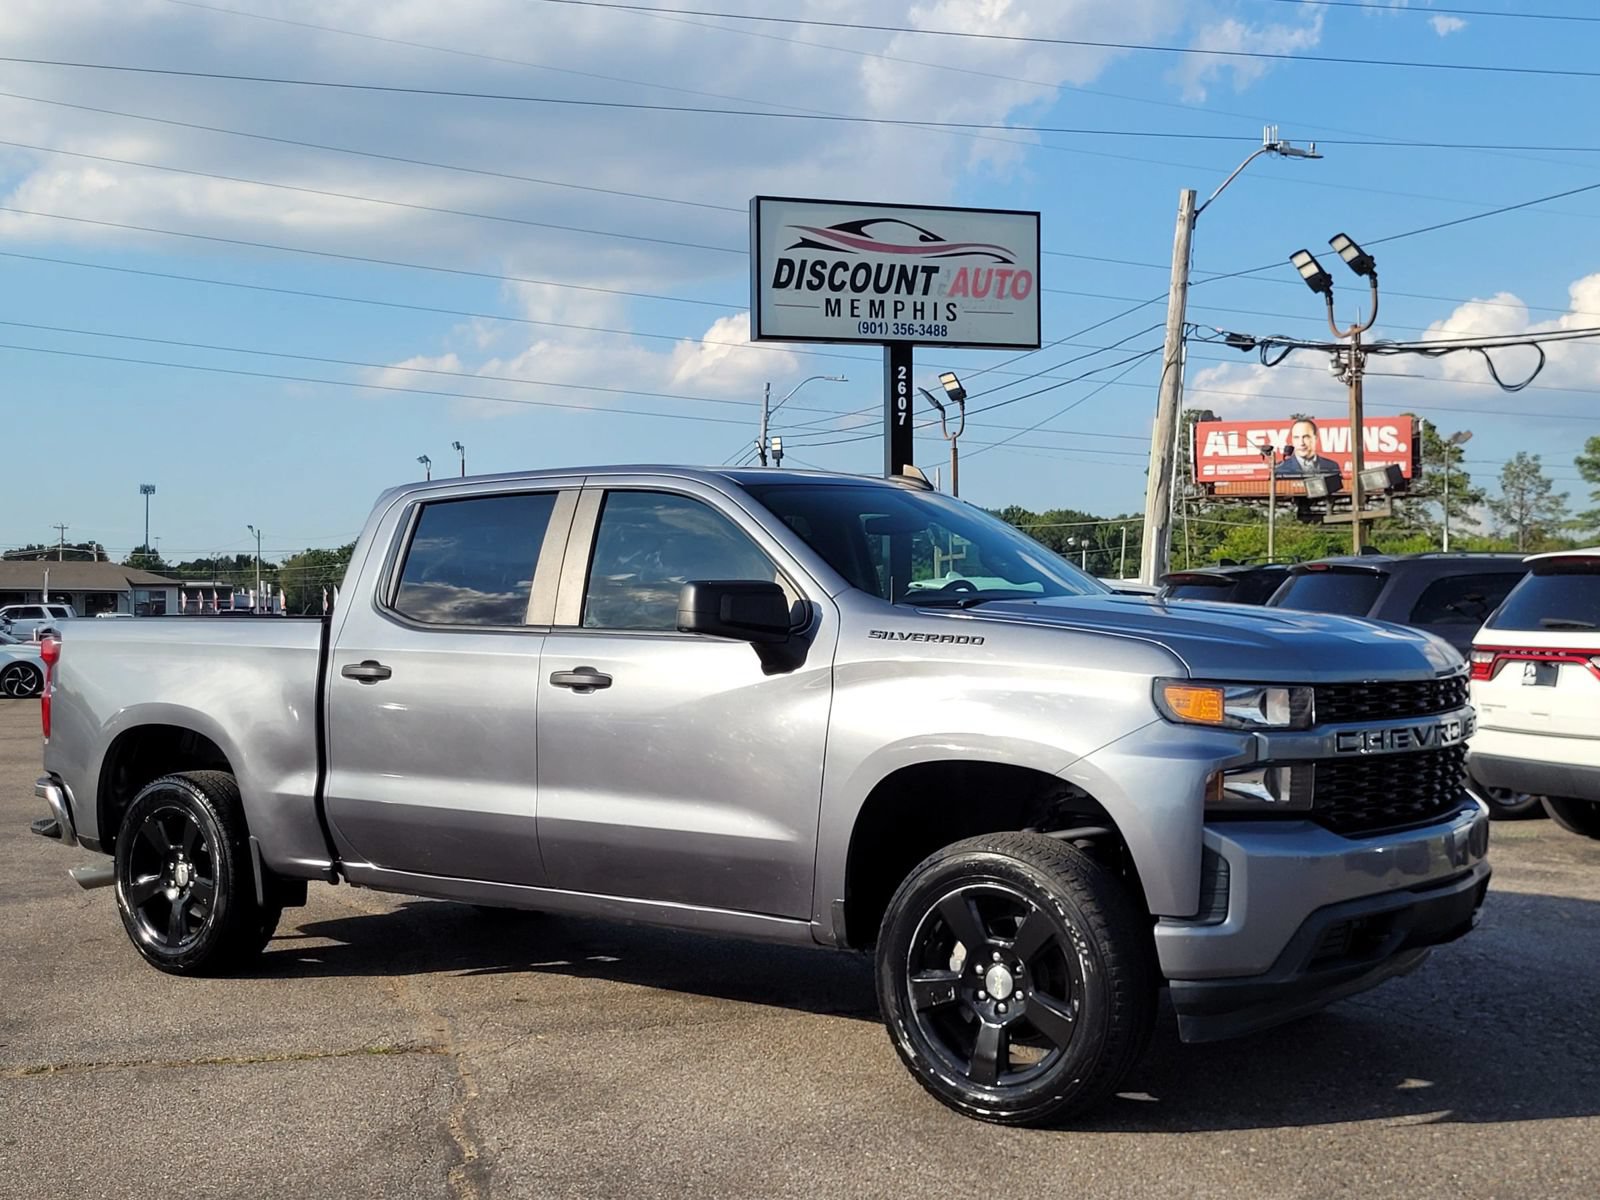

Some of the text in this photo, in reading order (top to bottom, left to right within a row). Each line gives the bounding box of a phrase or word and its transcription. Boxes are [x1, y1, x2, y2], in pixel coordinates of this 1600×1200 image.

[772, 258, 1033, 300] DISCOUNT AUTO
[824, 298, 957, 321] MEMPHIS
[857, 322, 948, 337] (901) 356-3488
[897, 366, 907, 425] 2607
[1203, 428, 1291, 456] ALEX
[868, 629, 985, 645] SILVERADO
